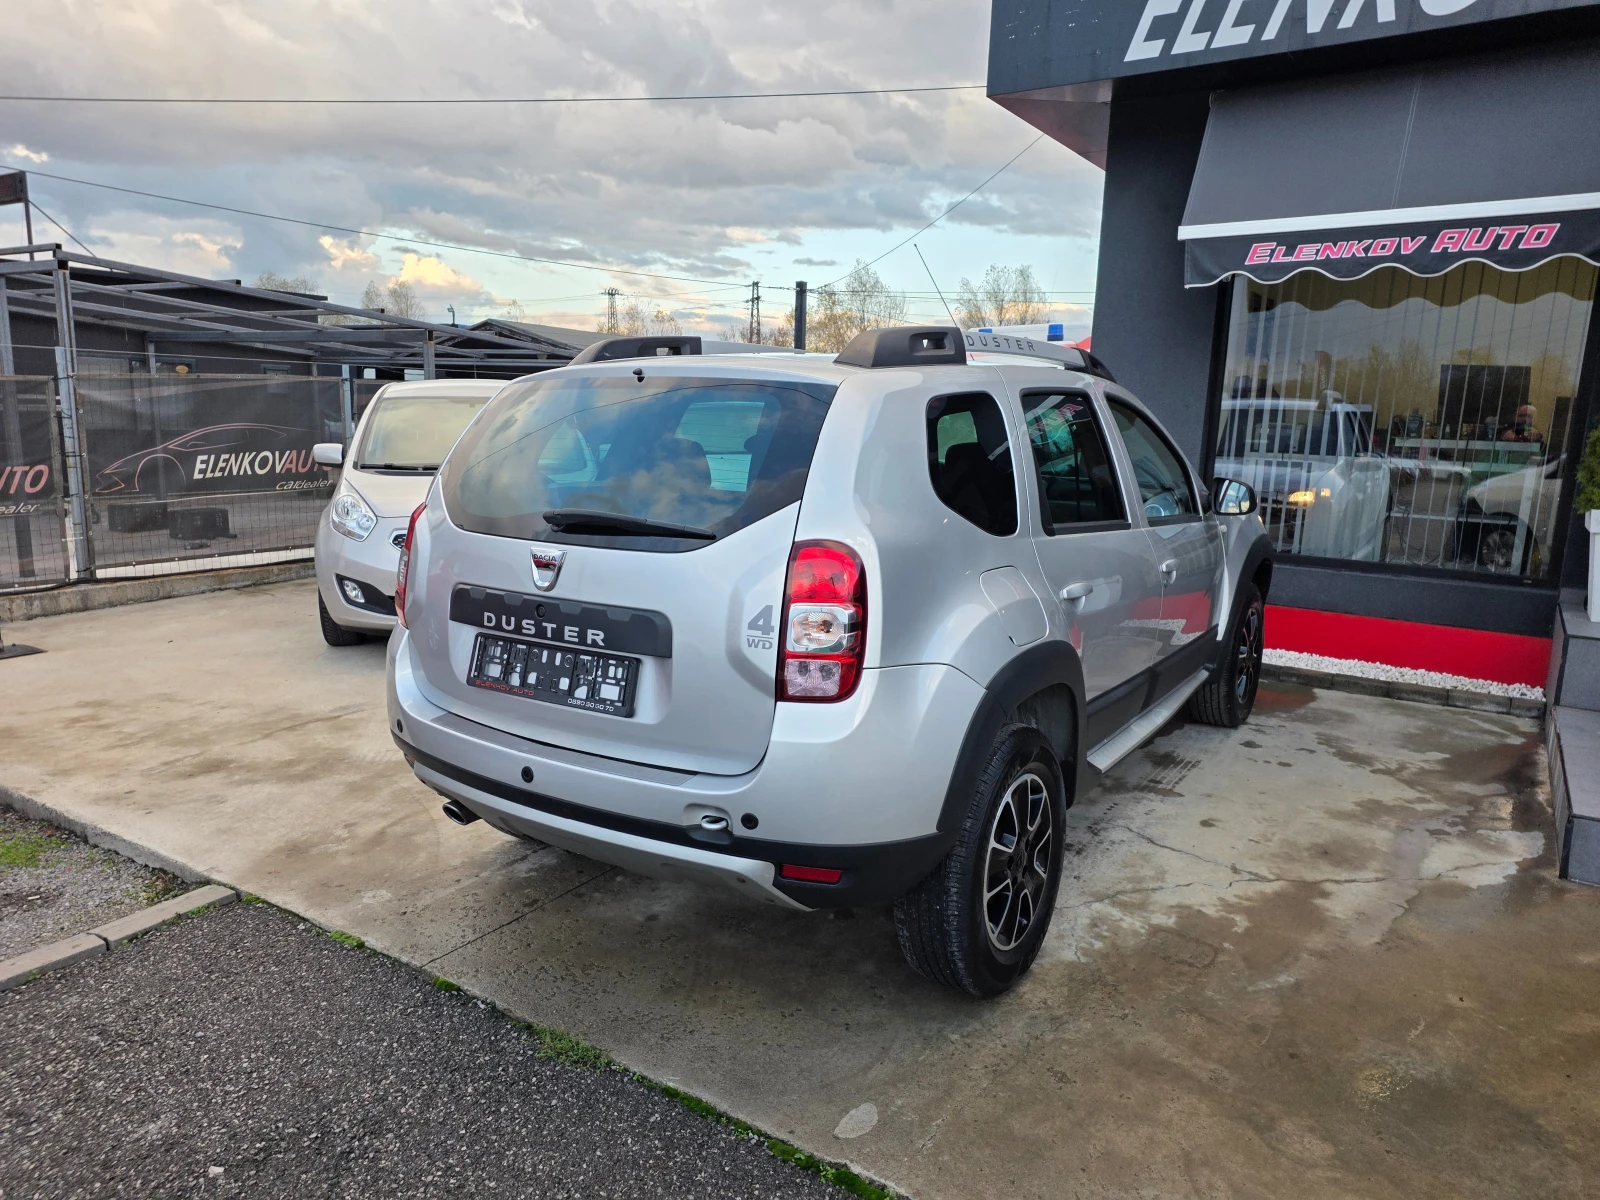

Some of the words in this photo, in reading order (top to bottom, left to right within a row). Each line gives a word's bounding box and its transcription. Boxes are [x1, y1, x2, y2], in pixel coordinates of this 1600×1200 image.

[1245, 236, 1427, 265] ELENKOV
[1430, 222, 1561, 253] AUTO
[965, 334, 1036, 352] DUSTER
[533, 553, 557, 562] DACIA
[483, 611, 605, 647] DUSTER
[747, 604, 775, 636] 4
[746, 637, 773, 650] WD
[513, 687, 535, 696] AUTO
